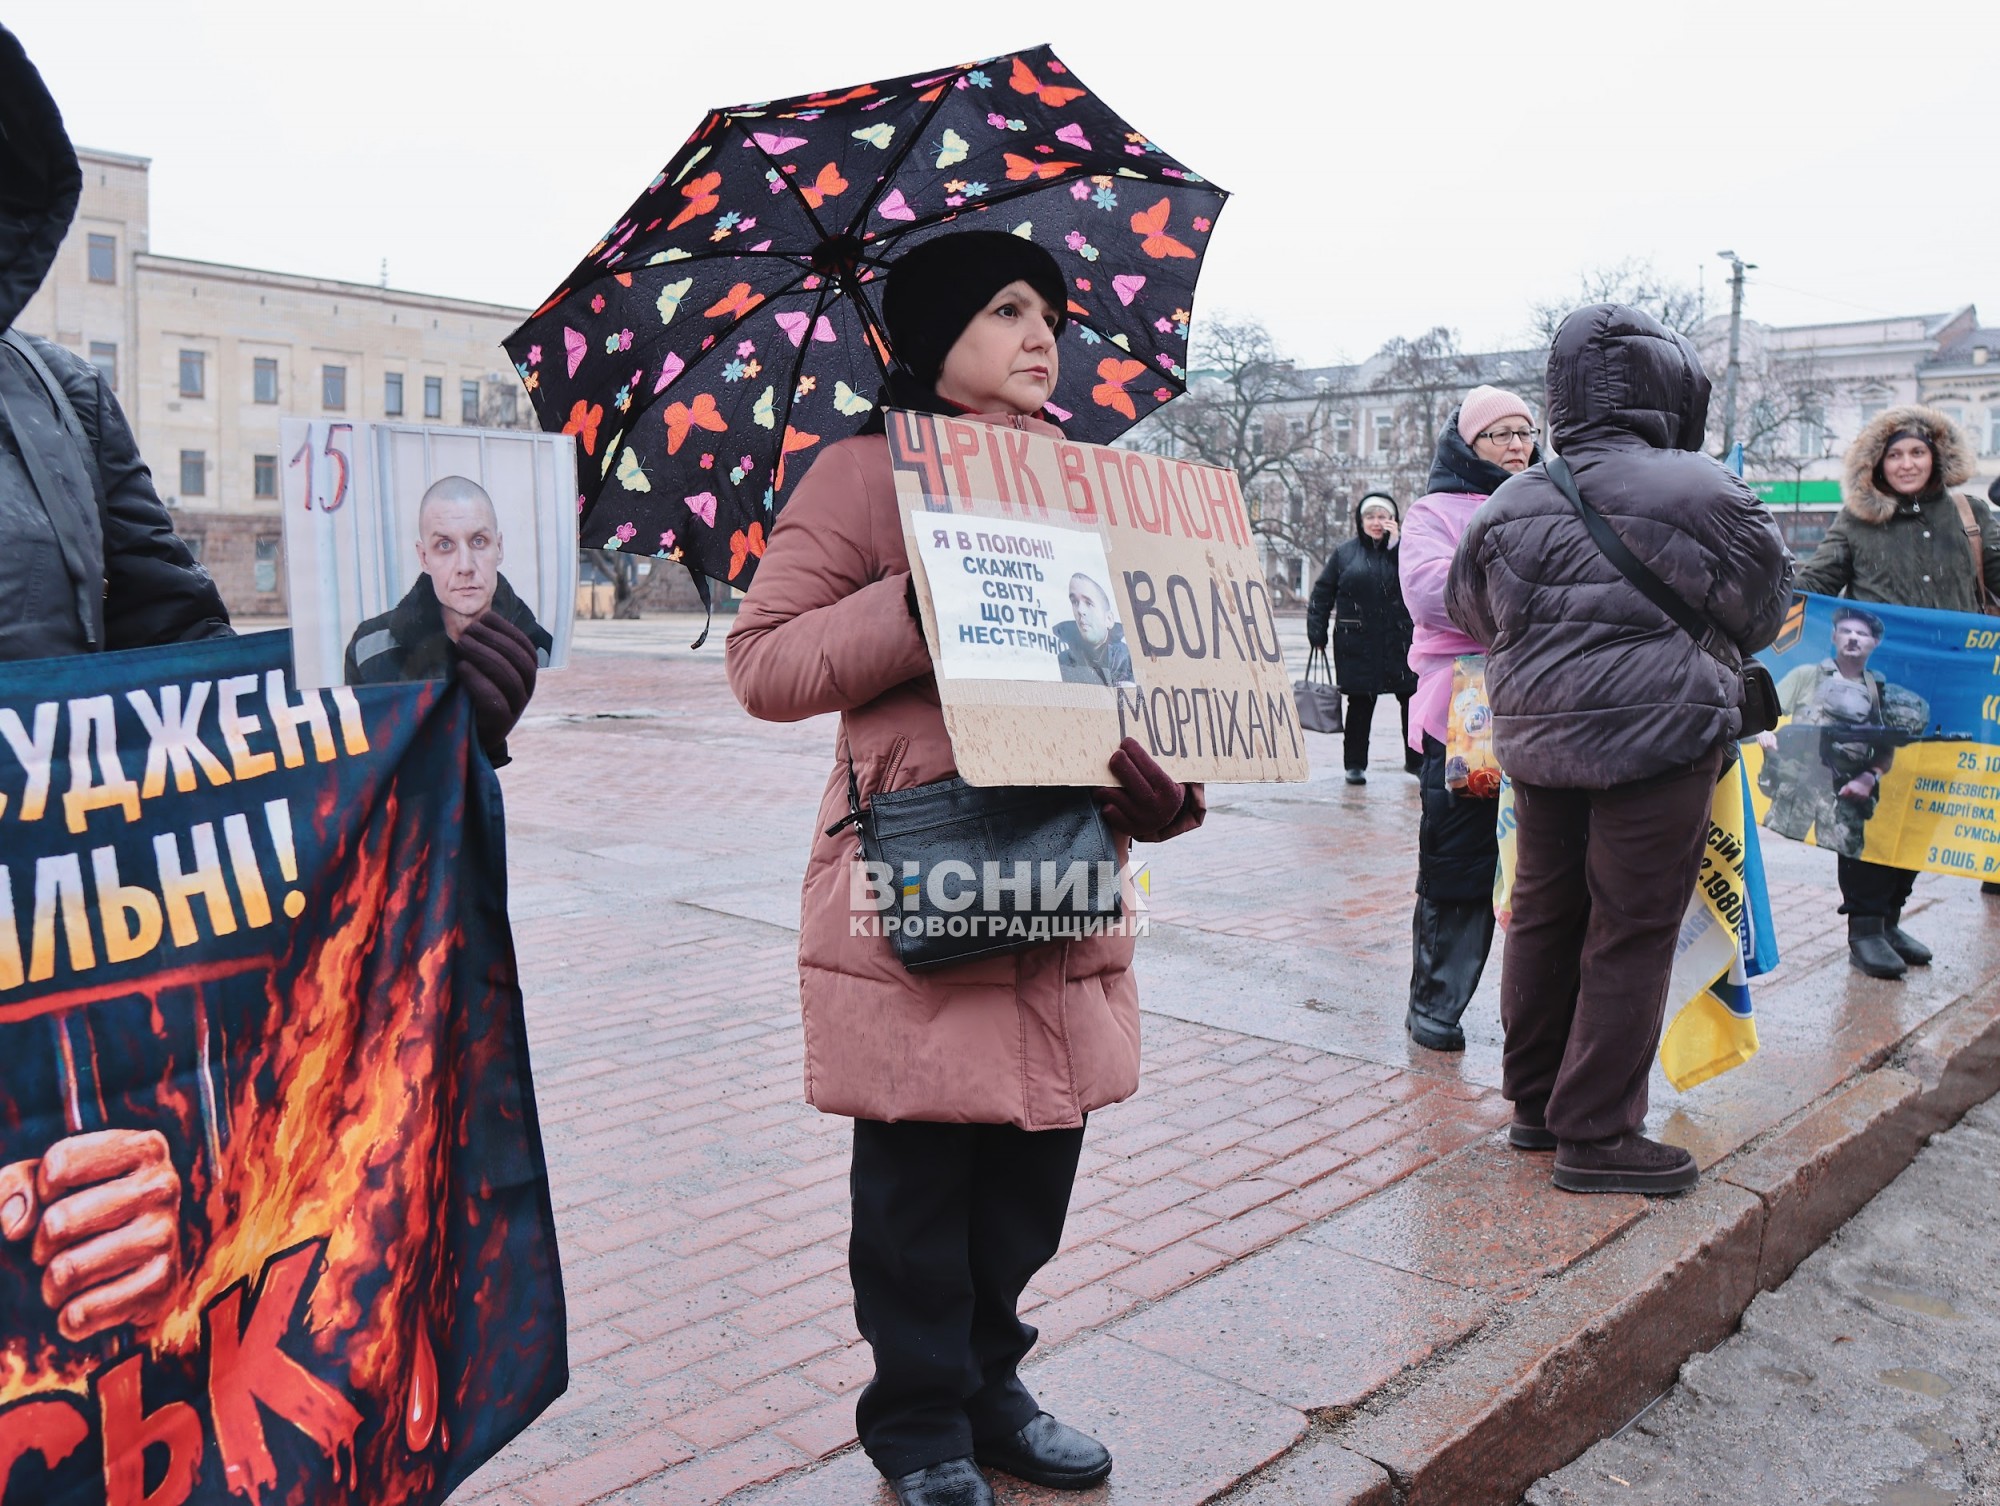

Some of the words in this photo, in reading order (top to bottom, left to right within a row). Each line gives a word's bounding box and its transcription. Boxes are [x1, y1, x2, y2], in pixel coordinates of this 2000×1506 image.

[289, 423, 353, 513] 15
[1053, 441, 1099, 525] В
[1093, 448, 1250, 547] ПОЛОНІ
[933, 529, 950, 549] Я
[956, 531, 972, 550] В
[976, 532, 1055, 560] ПОЛОНІ!
[962, 556, 1044, 583] СКАЖІТЬ
[981, 602, 1015, 625] ЩО
[1018, 606, 1048, 629] ТУТ
[1122, 569, 1282, 664] ВОЛЮ
[1965, 628, 2000, 650] БОГ
[1116, 685, 1300, 759] МОРПІХАМ
[0, 668, 370, 834] УДЖЕНІ
[1915, 777, 1946, 793] ЗНИК
